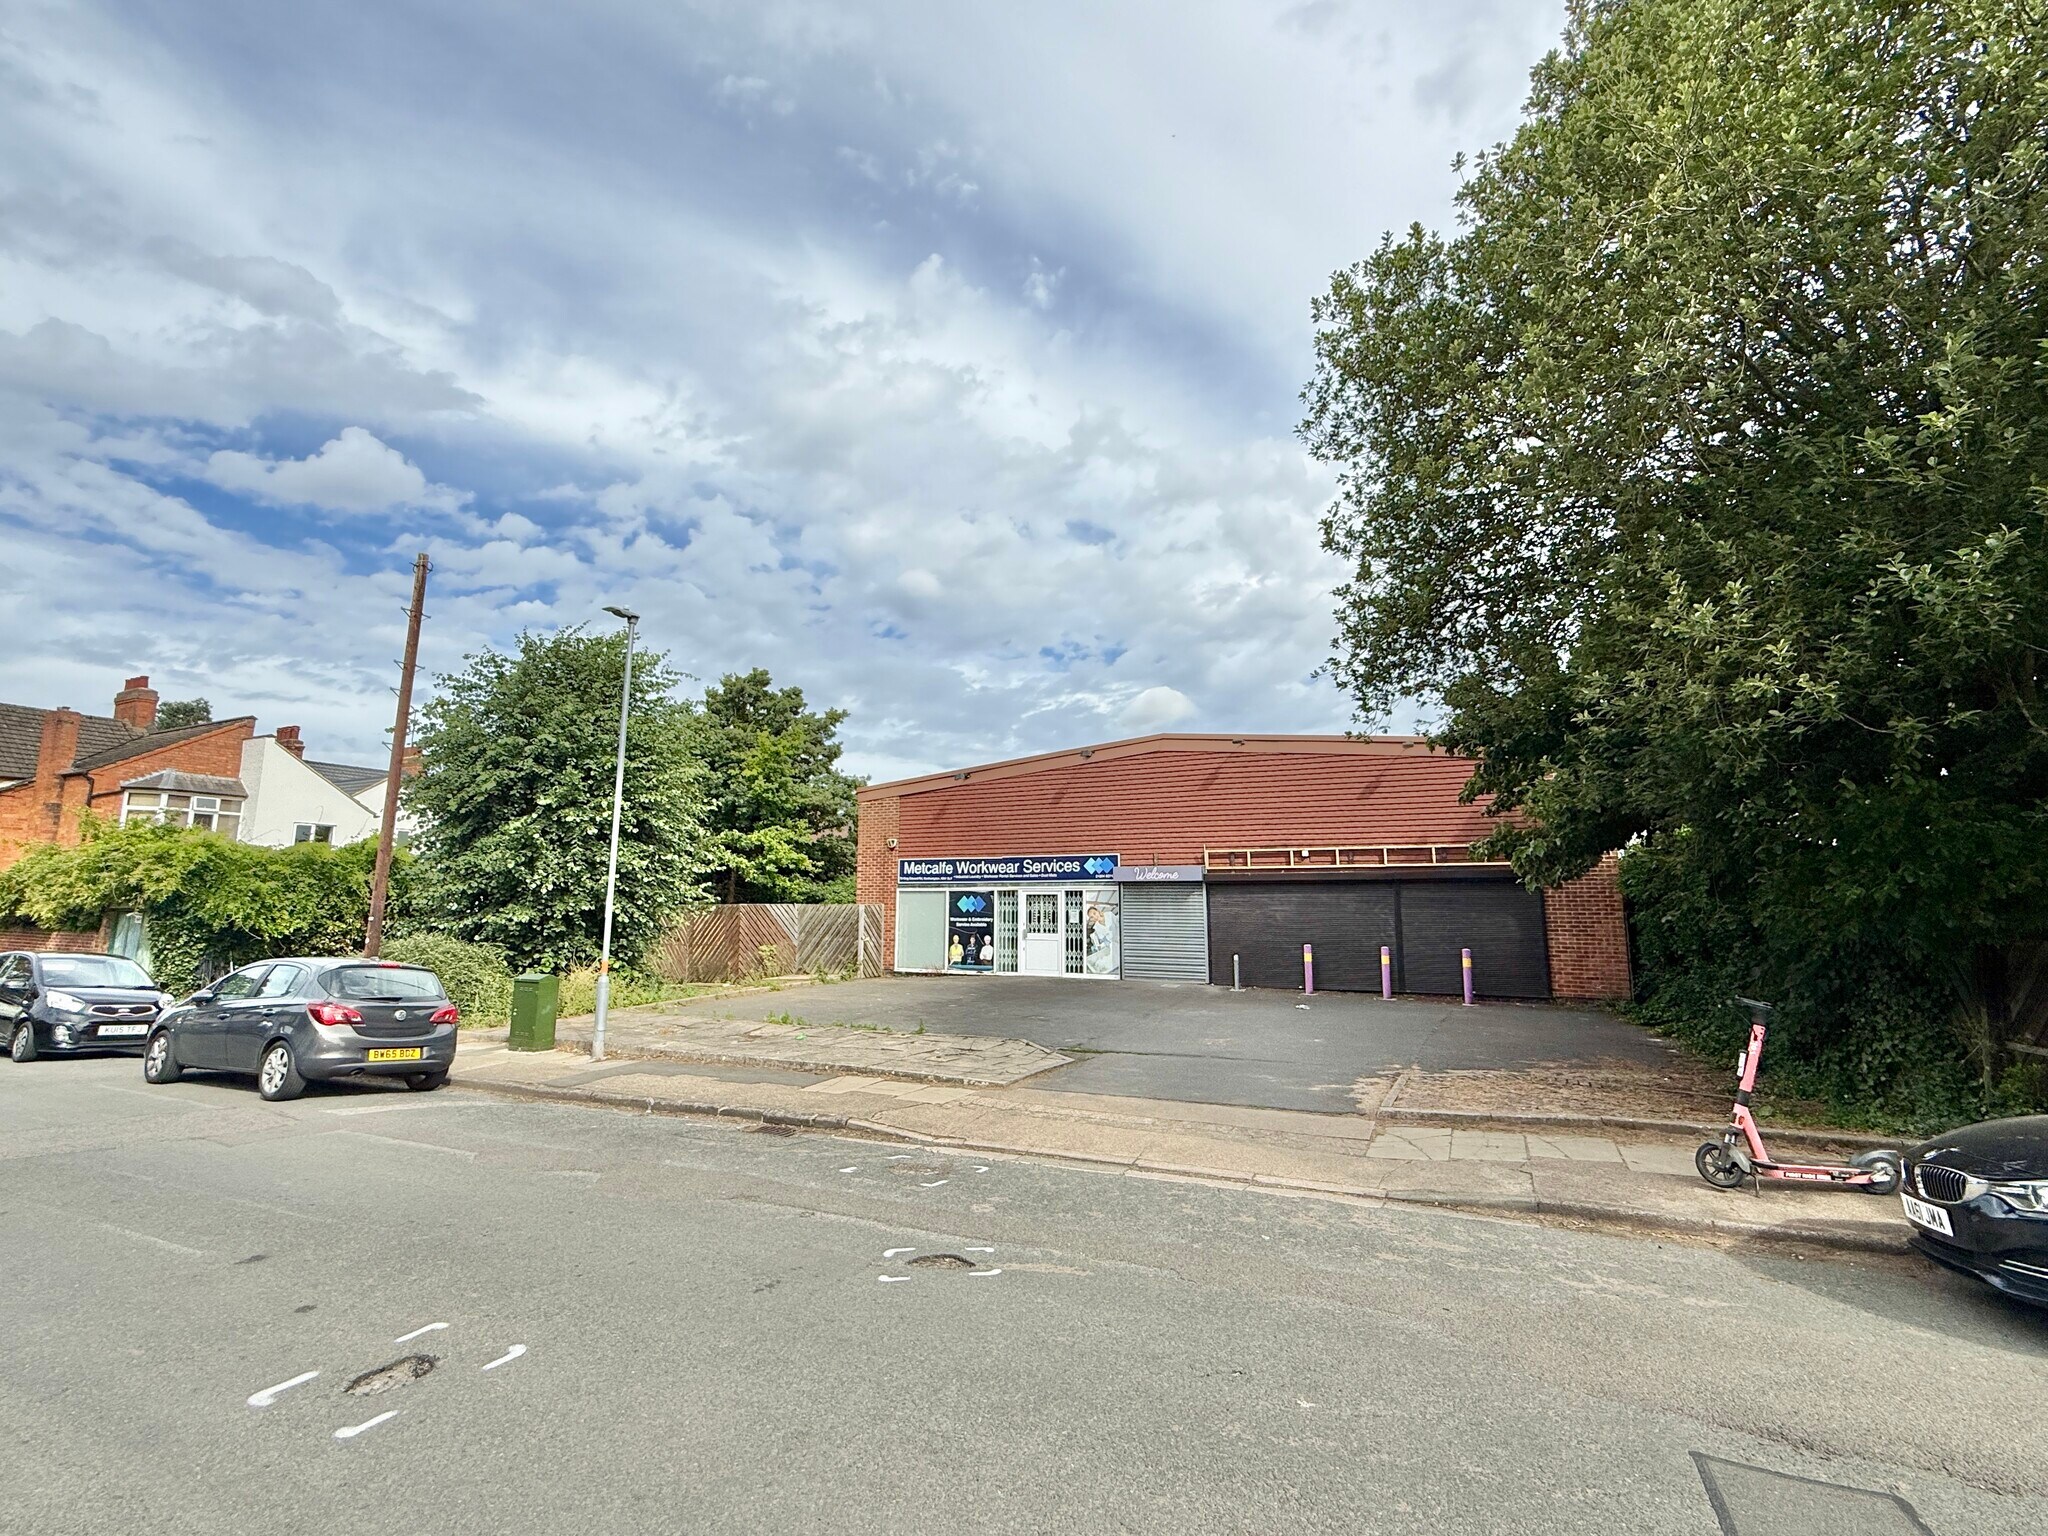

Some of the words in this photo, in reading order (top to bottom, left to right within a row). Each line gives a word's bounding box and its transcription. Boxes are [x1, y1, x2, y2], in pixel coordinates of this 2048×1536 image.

[904, 861, 954, 875] Metcalfe
[956, 860, 1019, 874] Workwear
[1023, 859, 1081, 873] Services
[1134, 867, 1179, 880] Welcome
[374, 1050, 397, 1059] BW65
